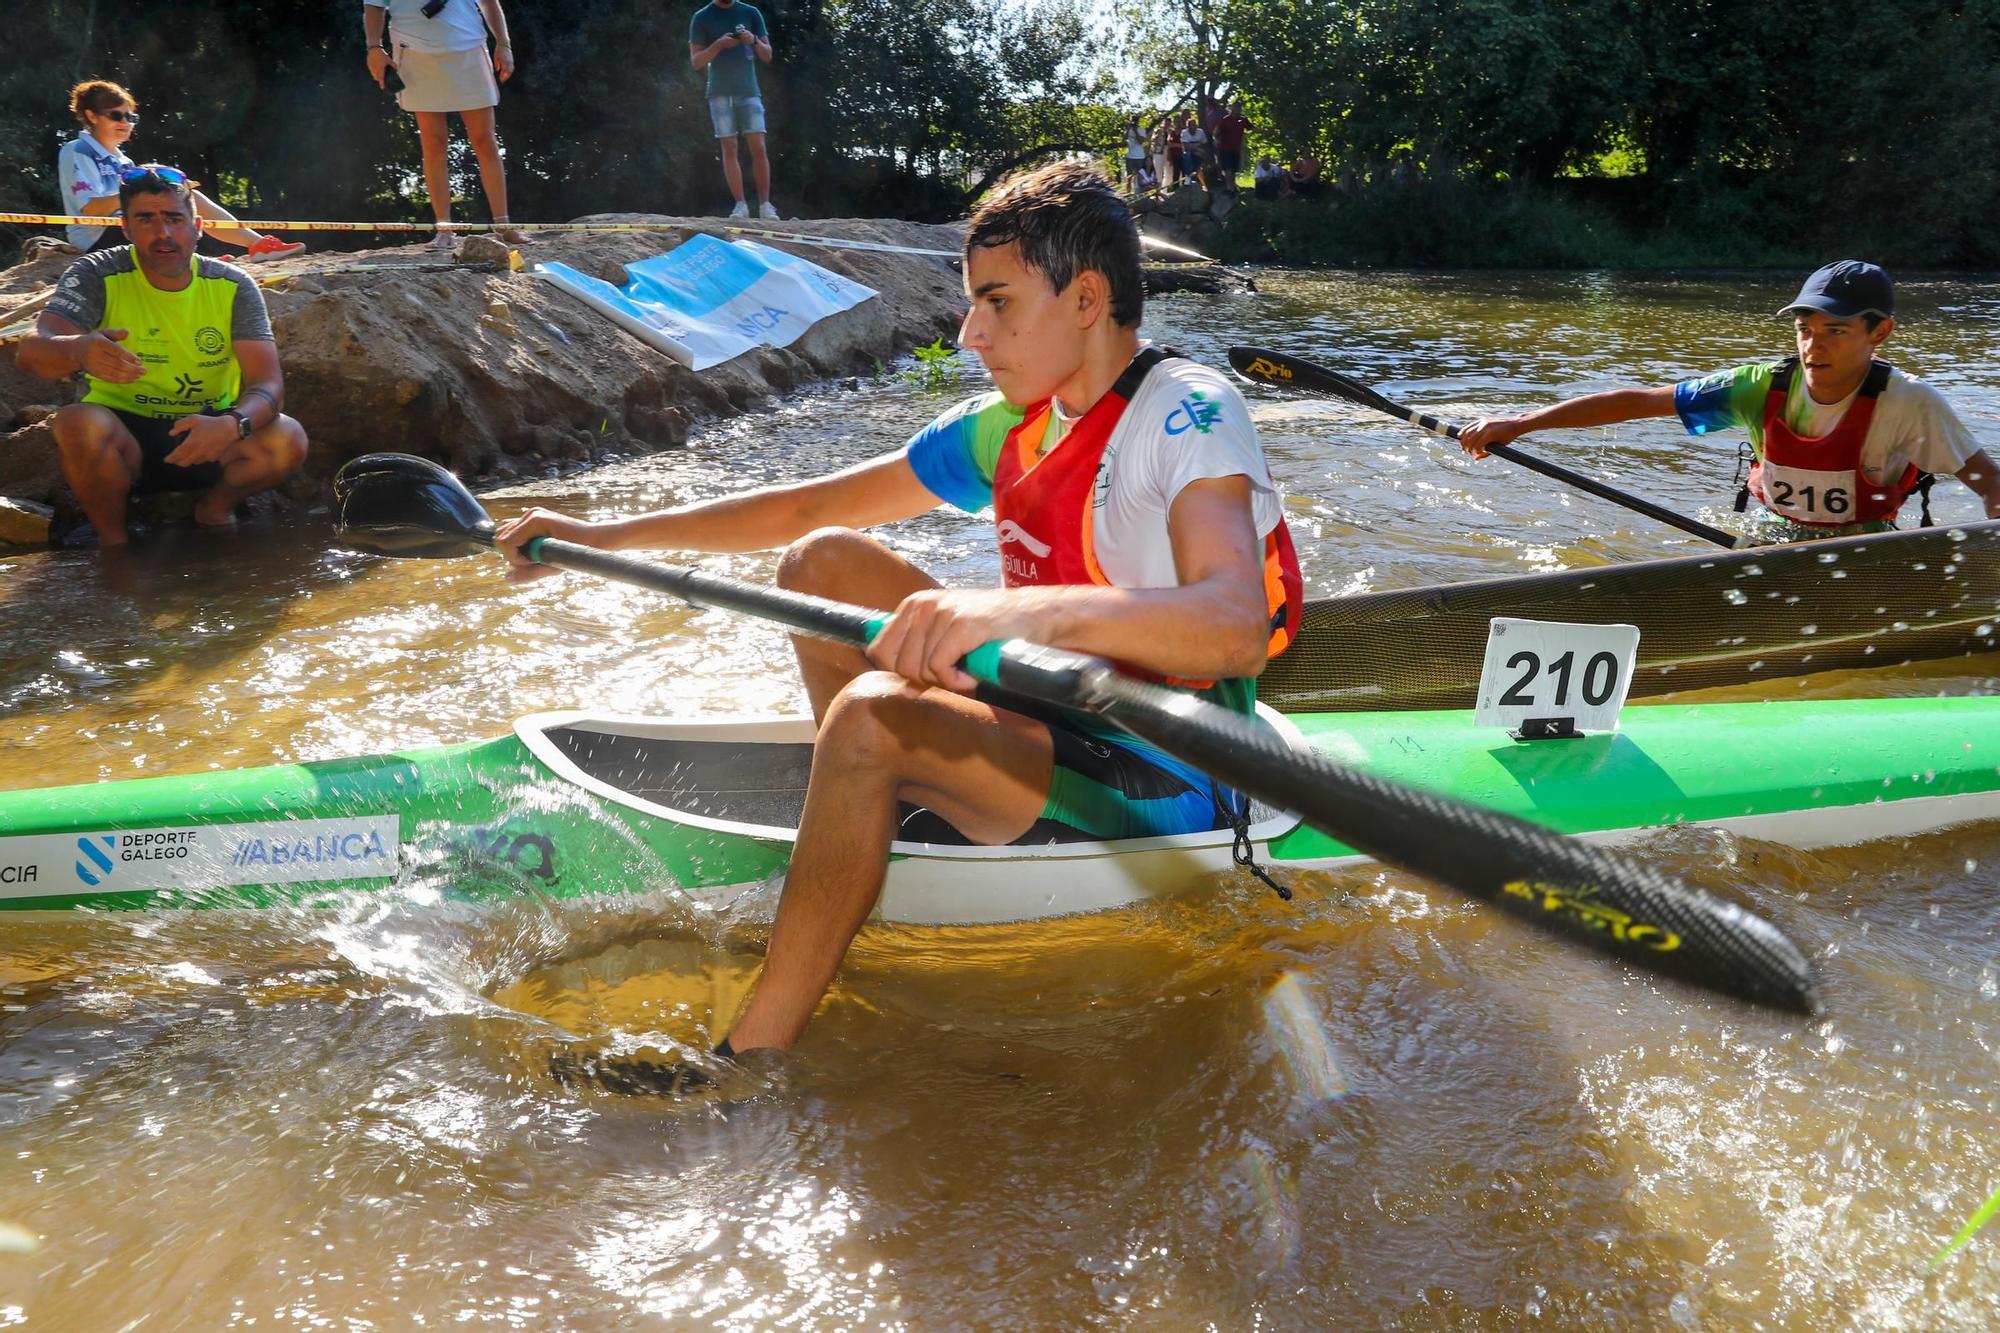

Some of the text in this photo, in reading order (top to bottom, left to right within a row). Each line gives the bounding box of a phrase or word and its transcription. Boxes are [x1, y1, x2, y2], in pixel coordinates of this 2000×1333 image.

[1773, 480, 1849, 514] 216
[1498, 650, 1619, 707] 210
[122, 831, 197, 847] DEPORTE
[121, 846, 188, 862] GALEGO
